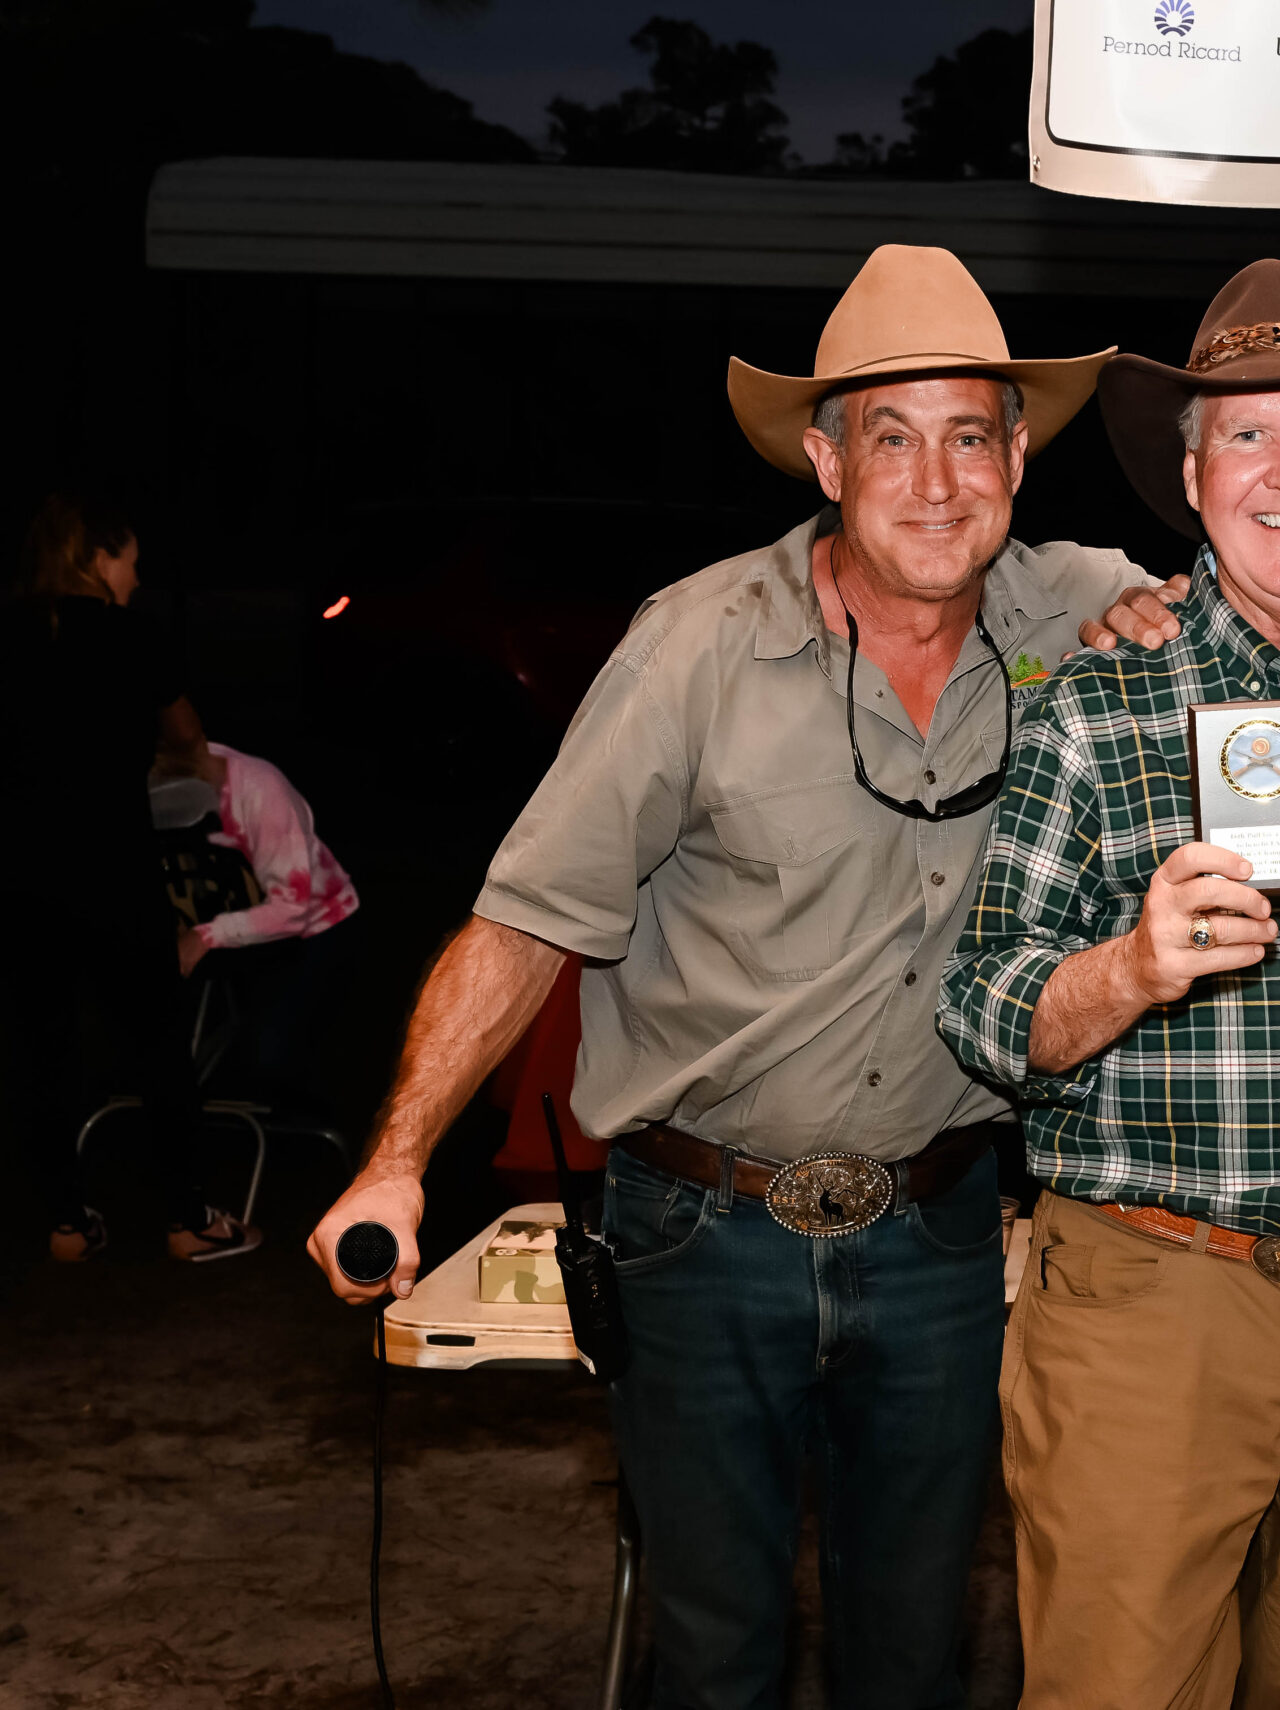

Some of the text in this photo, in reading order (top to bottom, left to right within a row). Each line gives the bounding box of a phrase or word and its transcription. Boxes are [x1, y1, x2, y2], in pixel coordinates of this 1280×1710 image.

[1103, 36, 1242, 62] Pernod Ricard
[772, 1195, 797, 1204] EST
